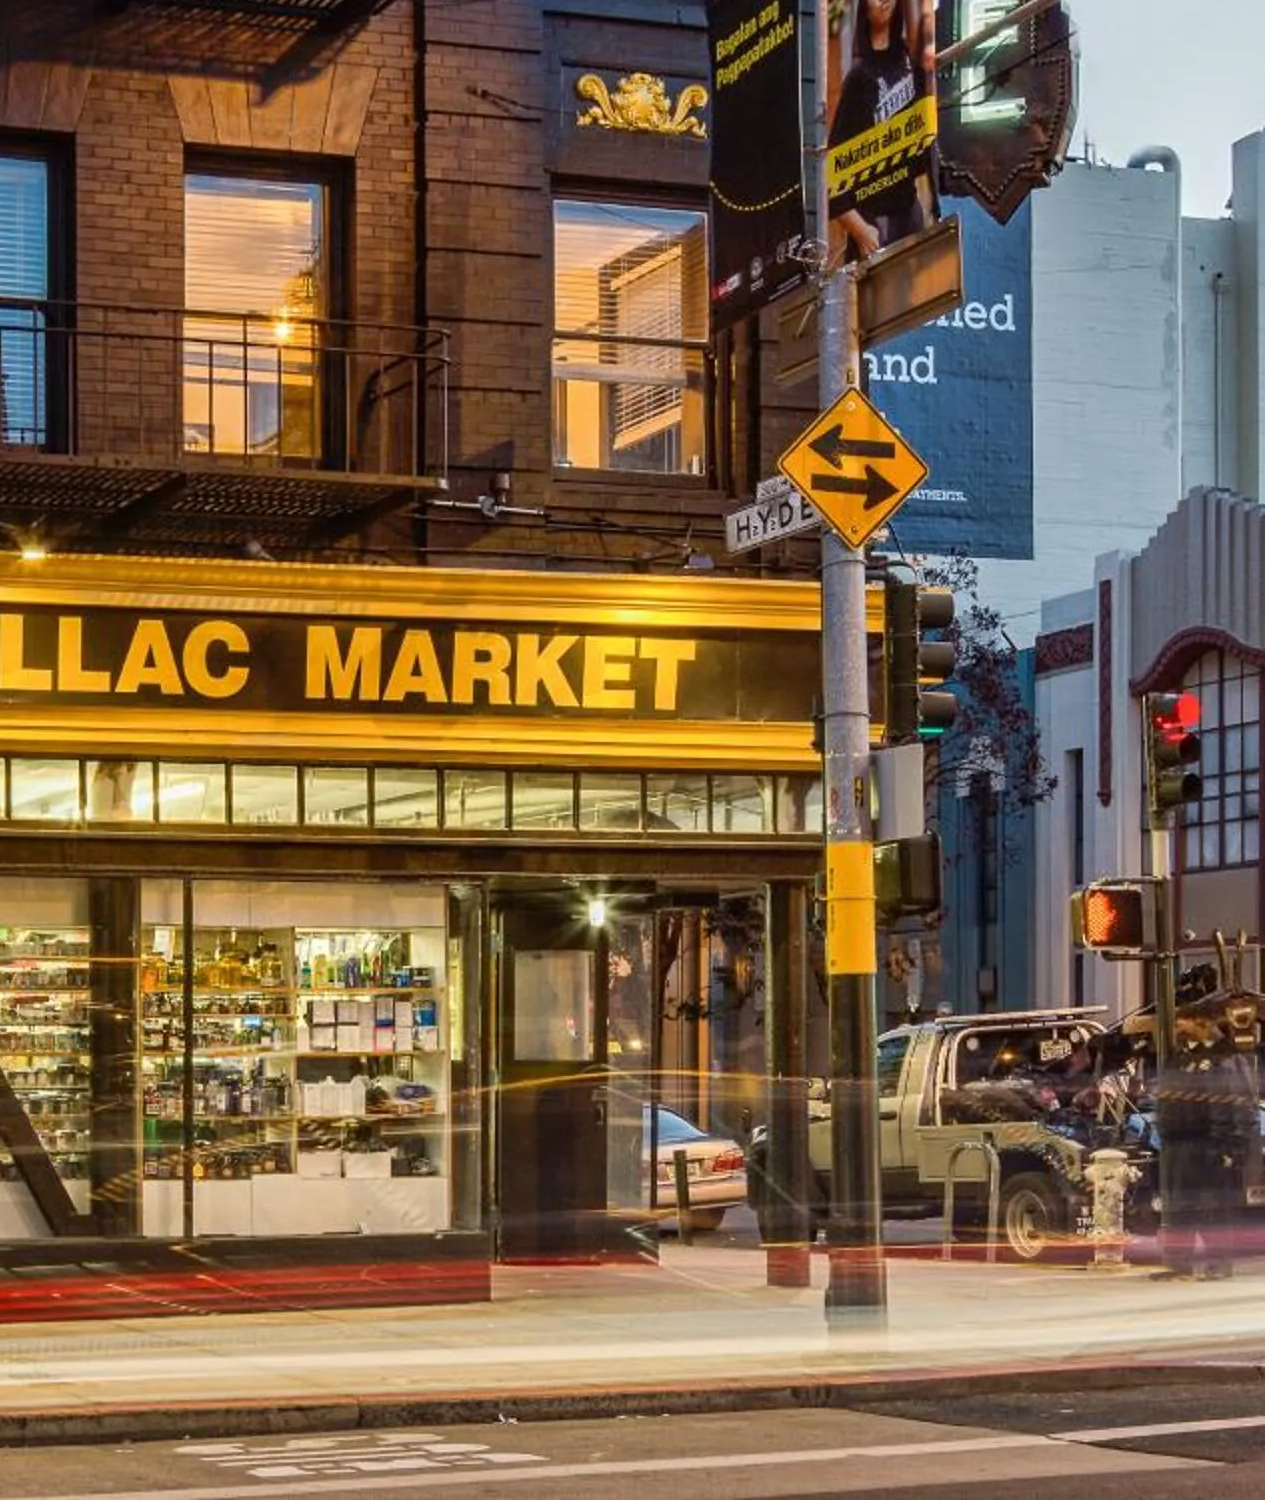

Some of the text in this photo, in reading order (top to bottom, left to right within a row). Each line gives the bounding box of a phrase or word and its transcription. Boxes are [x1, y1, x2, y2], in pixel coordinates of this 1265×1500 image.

[759, 0, 780, 28] ang
[736, 497, 813, 543] HYDE
[305, 625, 697, 711] MARKET
